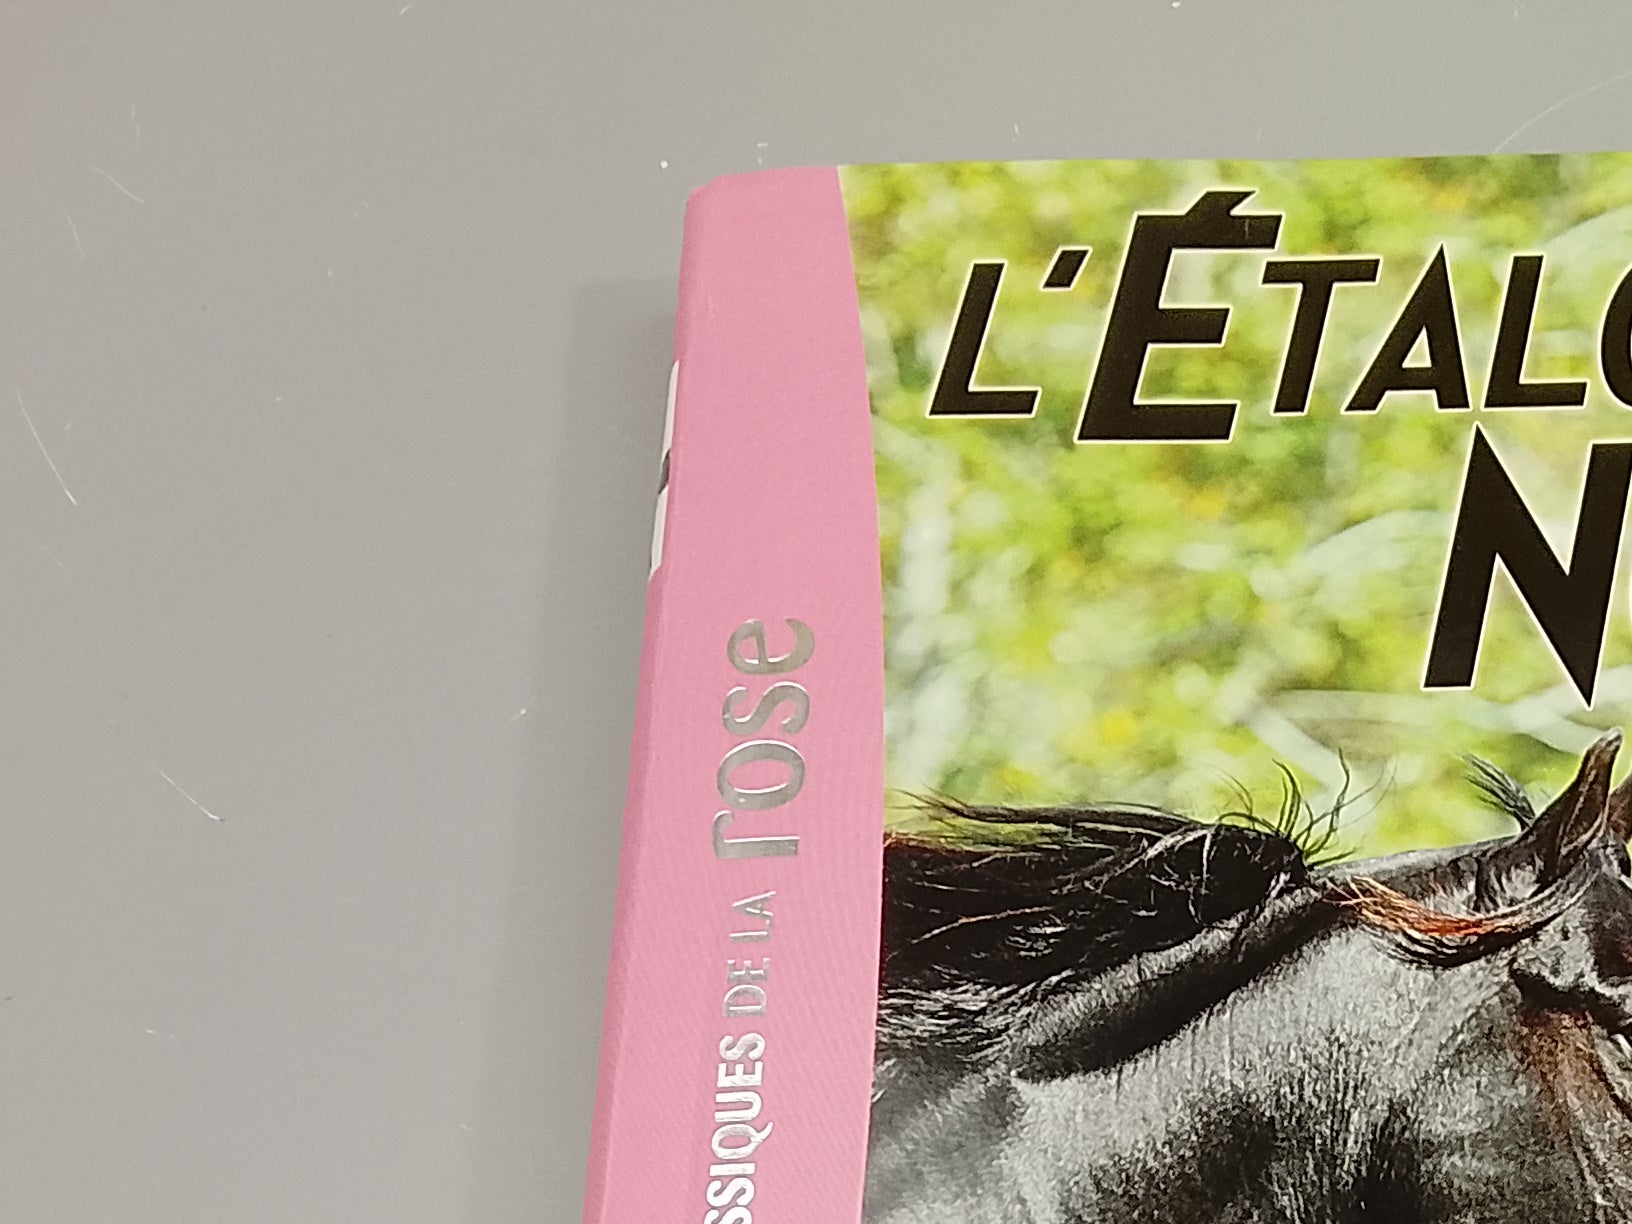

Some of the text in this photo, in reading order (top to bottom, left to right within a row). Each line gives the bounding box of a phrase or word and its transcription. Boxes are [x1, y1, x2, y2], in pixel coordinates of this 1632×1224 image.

[712, 615, 816, 860] rose
[730, 889, 778, 943] LA
[722, 956, 771, 1019] DE
